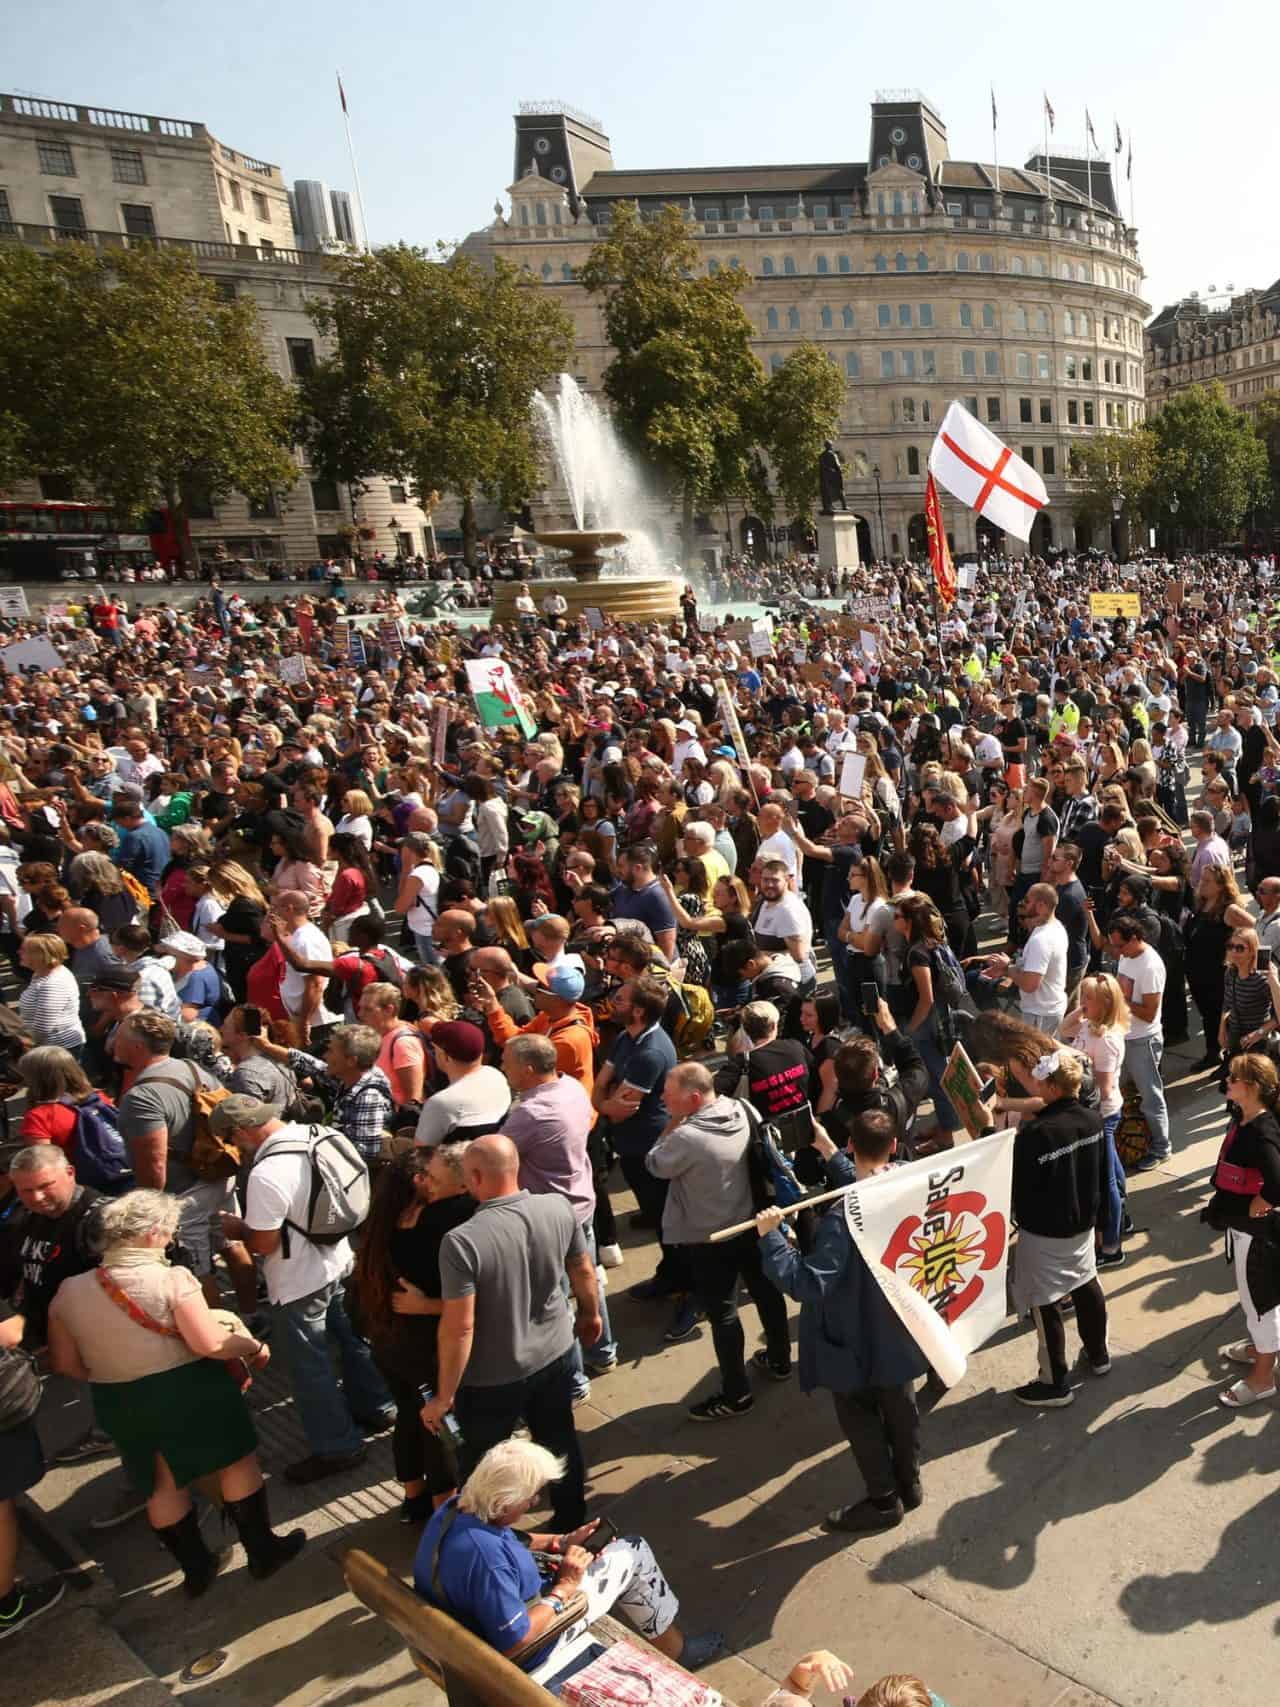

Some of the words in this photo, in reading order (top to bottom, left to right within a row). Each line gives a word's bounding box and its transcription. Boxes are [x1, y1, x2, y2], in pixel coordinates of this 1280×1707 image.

[925, 1166, 965, 1236] Save
[923, 1239, 957, 1284] US
[928, 1284, 957, 1315] N
